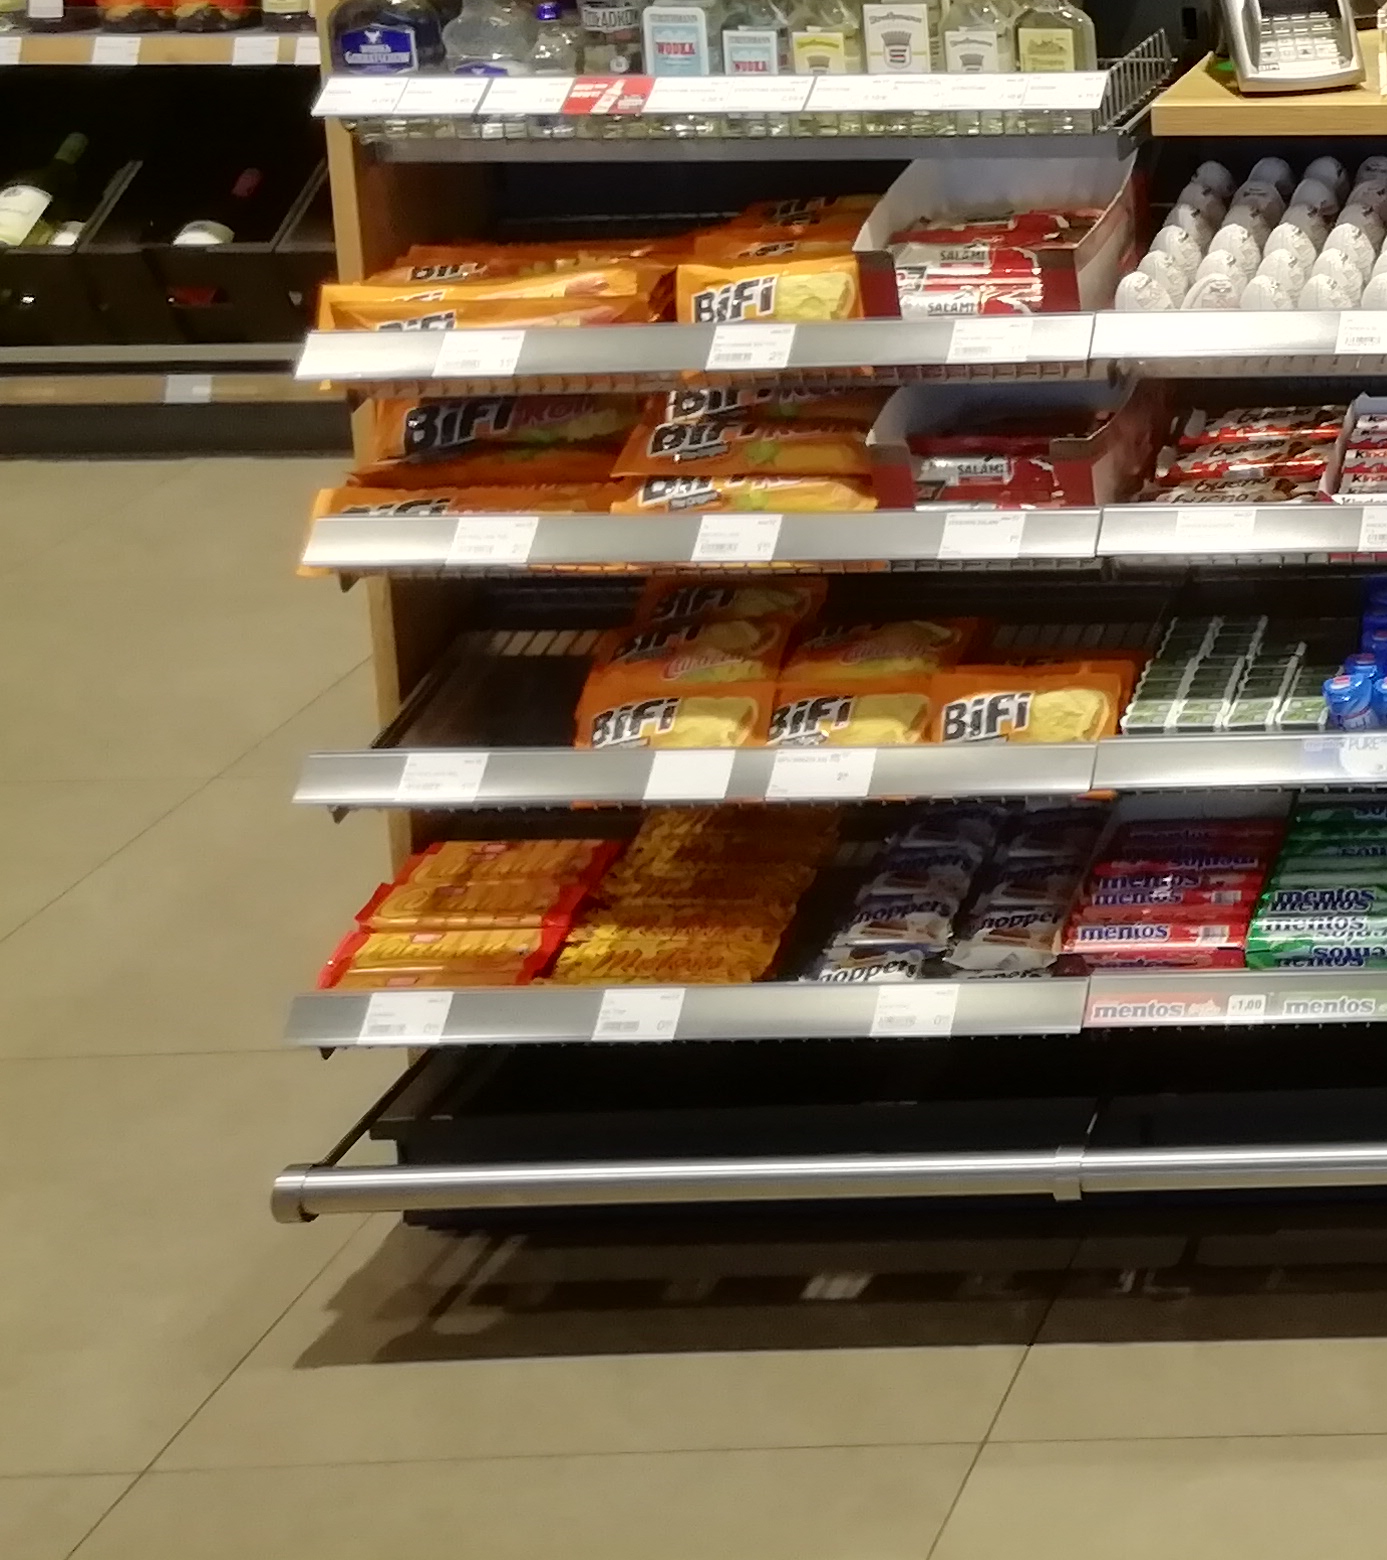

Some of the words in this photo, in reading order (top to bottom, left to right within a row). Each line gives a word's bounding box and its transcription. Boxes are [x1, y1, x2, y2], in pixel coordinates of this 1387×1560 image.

[1078, 926, 1168, 942] mentos
[1095, 1003, 1184, 1018] mentos
[1283, 999, 1374, 1014] mentos
